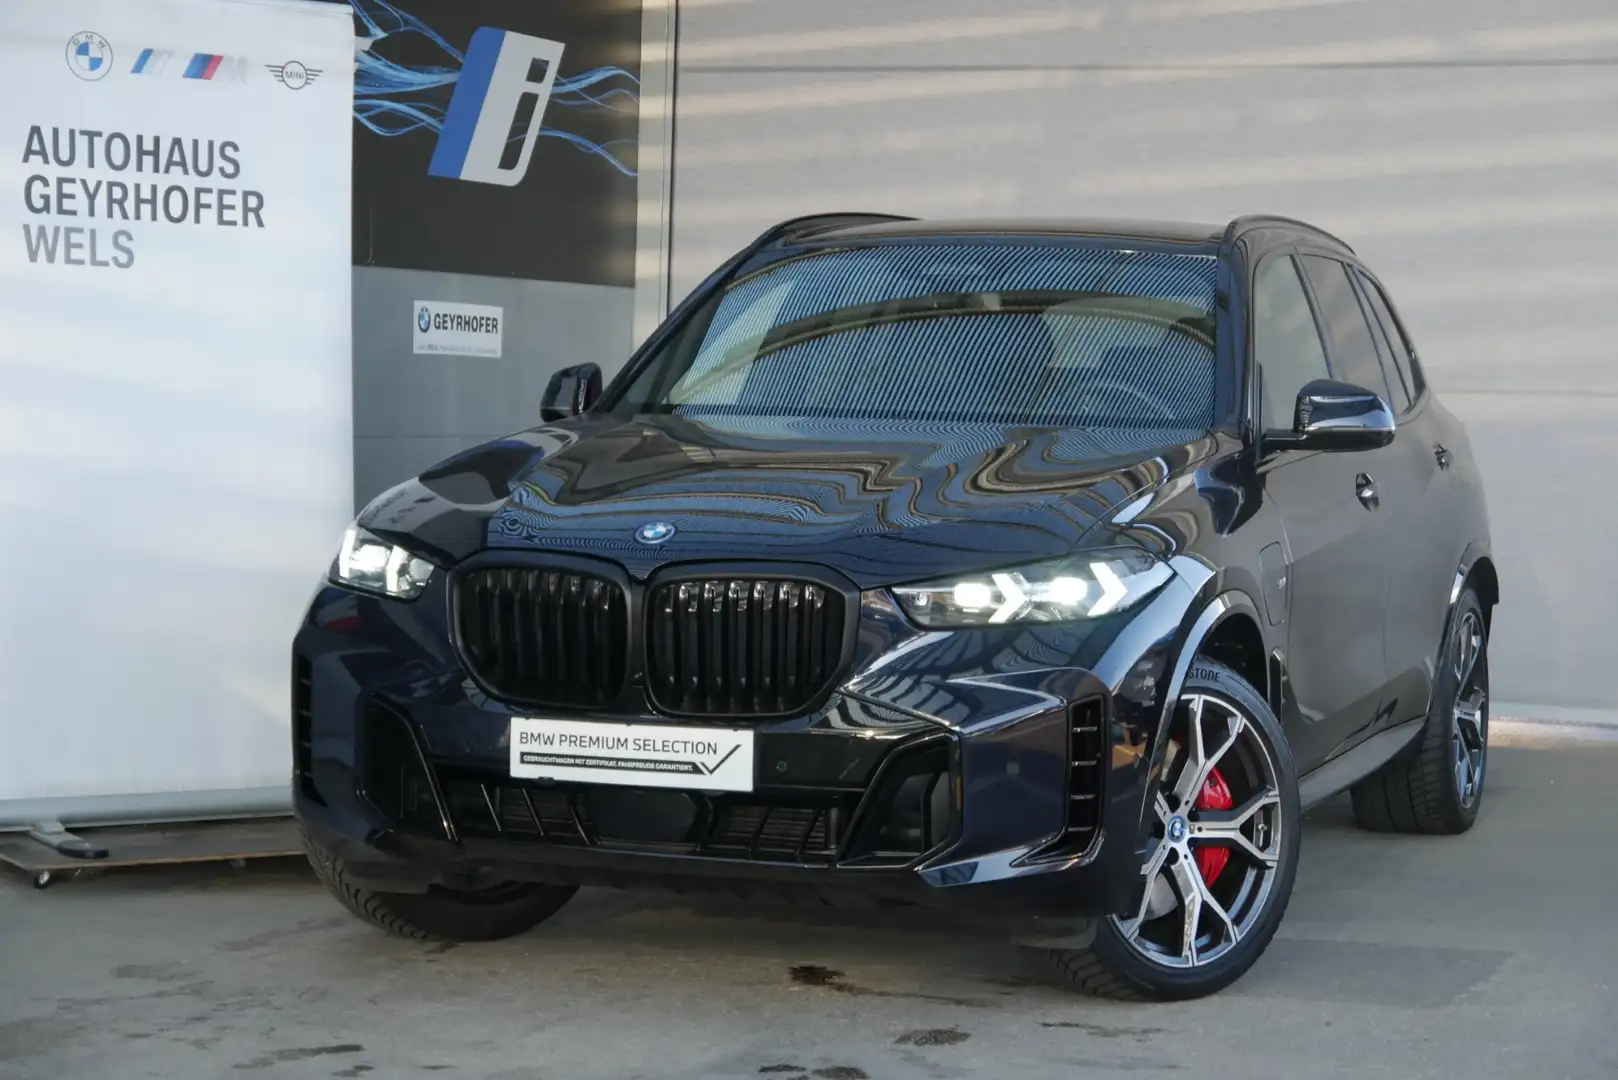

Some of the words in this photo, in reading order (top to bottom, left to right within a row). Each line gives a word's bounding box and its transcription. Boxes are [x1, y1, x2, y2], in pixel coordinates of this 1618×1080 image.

[285, 71, 305, 80] MINI
[22, 125, 240, 179] AUTOHAUS
[24, 174, 265, 228] GEYRHOFER
[22, 224, 134, 269] WELS
[434, 312, 498, 334] GEYRHOFER
[519, 731, 555, 746] BMW
[559, 734, 629, 751] PREMIUM
[632, 738, 717, 755] SELECTION
